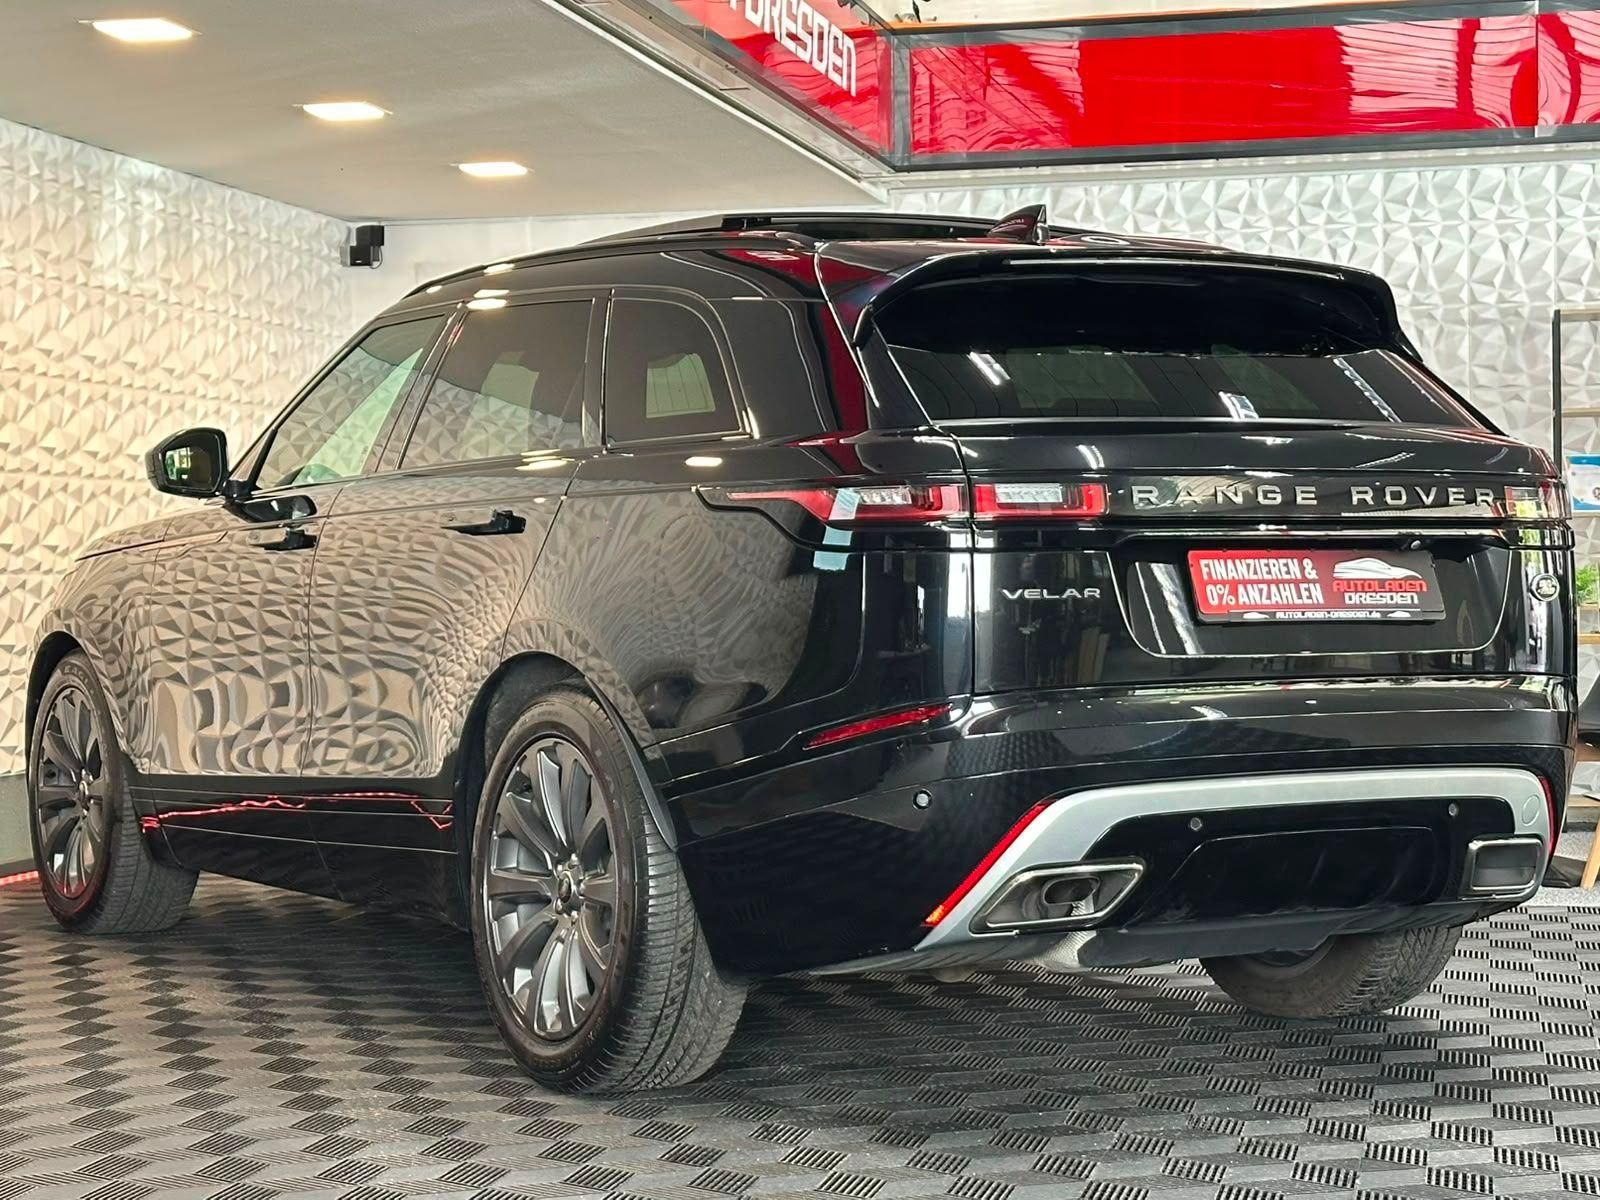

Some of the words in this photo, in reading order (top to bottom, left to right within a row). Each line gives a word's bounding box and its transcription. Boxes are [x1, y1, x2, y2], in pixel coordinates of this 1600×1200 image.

[1131, 485, 1318, 506] RANGE
[1350, 486, 1494, 508] ROVER
[1200, 558, 1301, 581] FINANZIEREN
[1303, 558, 1318, 580] &
[1002, 588, 1101, 600] VELAR
[1206, 583, 1236, 606] 0%
[1237, 582, 1325, 606] ANZAHLEN
[1332, 580, 1428, 593] AUTOLADEN
[1344, 592, 1419, 605] DRESDEN
